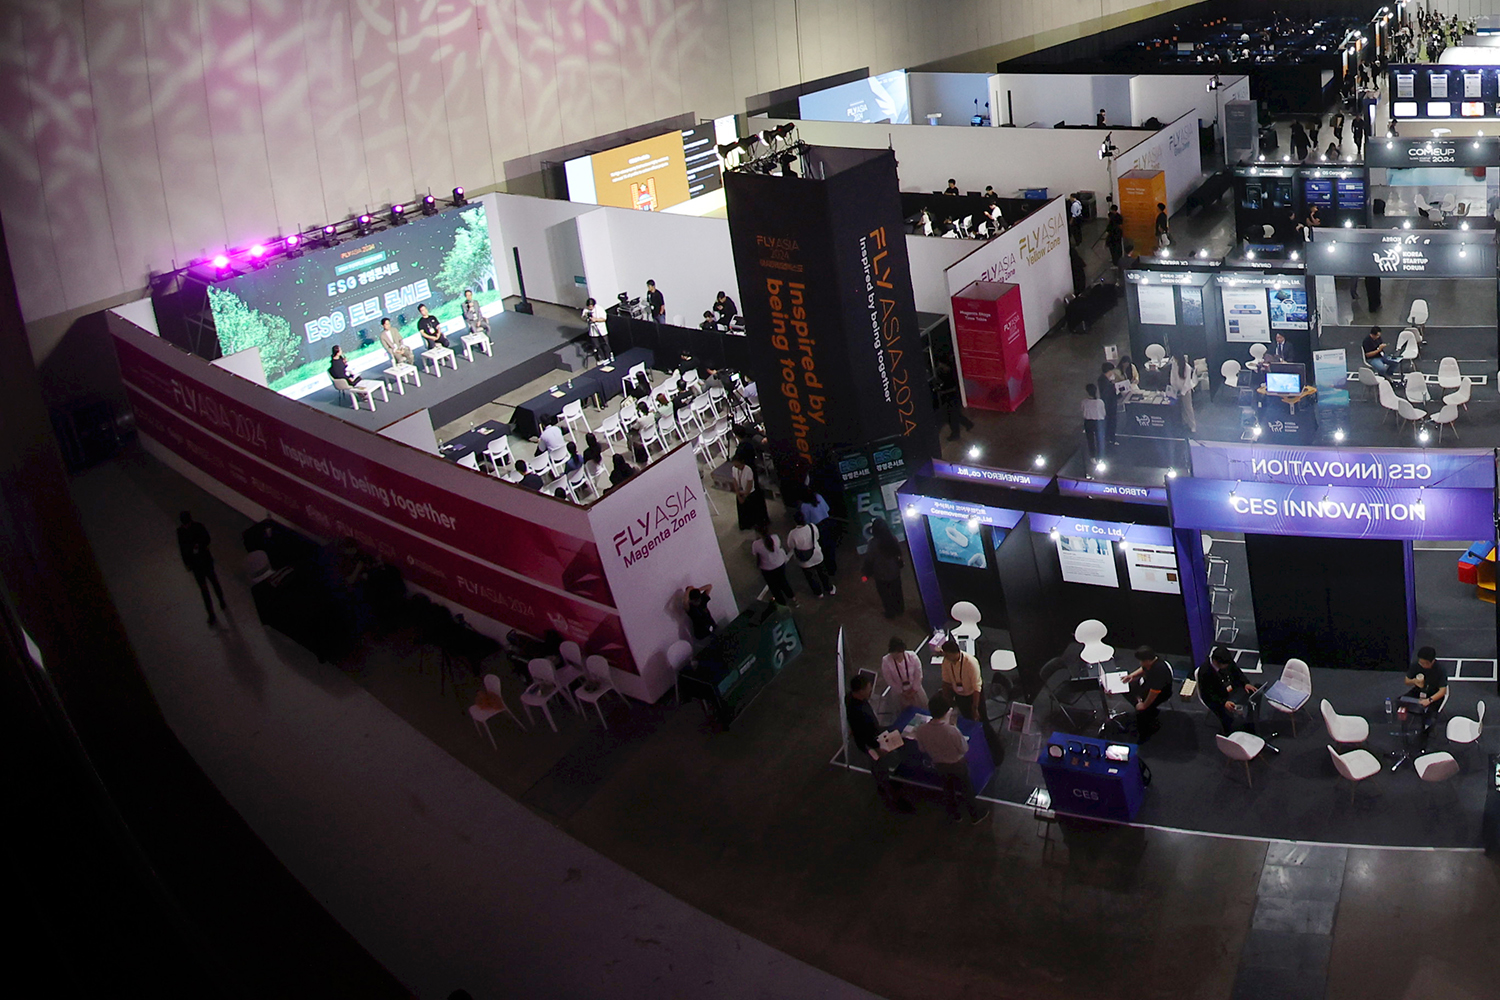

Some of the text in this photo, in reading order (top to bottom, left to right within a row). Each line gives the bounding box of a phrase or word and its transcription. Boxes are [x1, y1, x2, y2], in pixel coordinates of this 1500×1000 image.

[1408, 148, 1455, 156] COMEUP
[756, 235, 800, 251] FLYASIA
[1019, 212, 1065, 260] FLYASIA
[1026, 235, 1062, 267] Yellow Zone
[327, 275, 357, 297] ESG
[358, 261, 401, 287] 경영콘서트
[304, 278, 432, 344] ESG 토크 콘서트
[859, 236, 892, 403] Inspired by being together
[869, 226, 917, 437] FLYASIA 2024
[766, 278, 791, 351] being
[780, 357, 814, 465] together
[789, 281, 829, 425] Inspired by
[280, 440, 457, 531] Inspired by being together
[1233, 497, 1426, 521] CES INNOVATION
[613, 485, 698, 557] FLYASIA
[623, 508, 698, 569] Magenta Zone
[1075, 523, 1124, 537] CIT Co. Ltd.
[1073, 788, 1099, 801] CES
